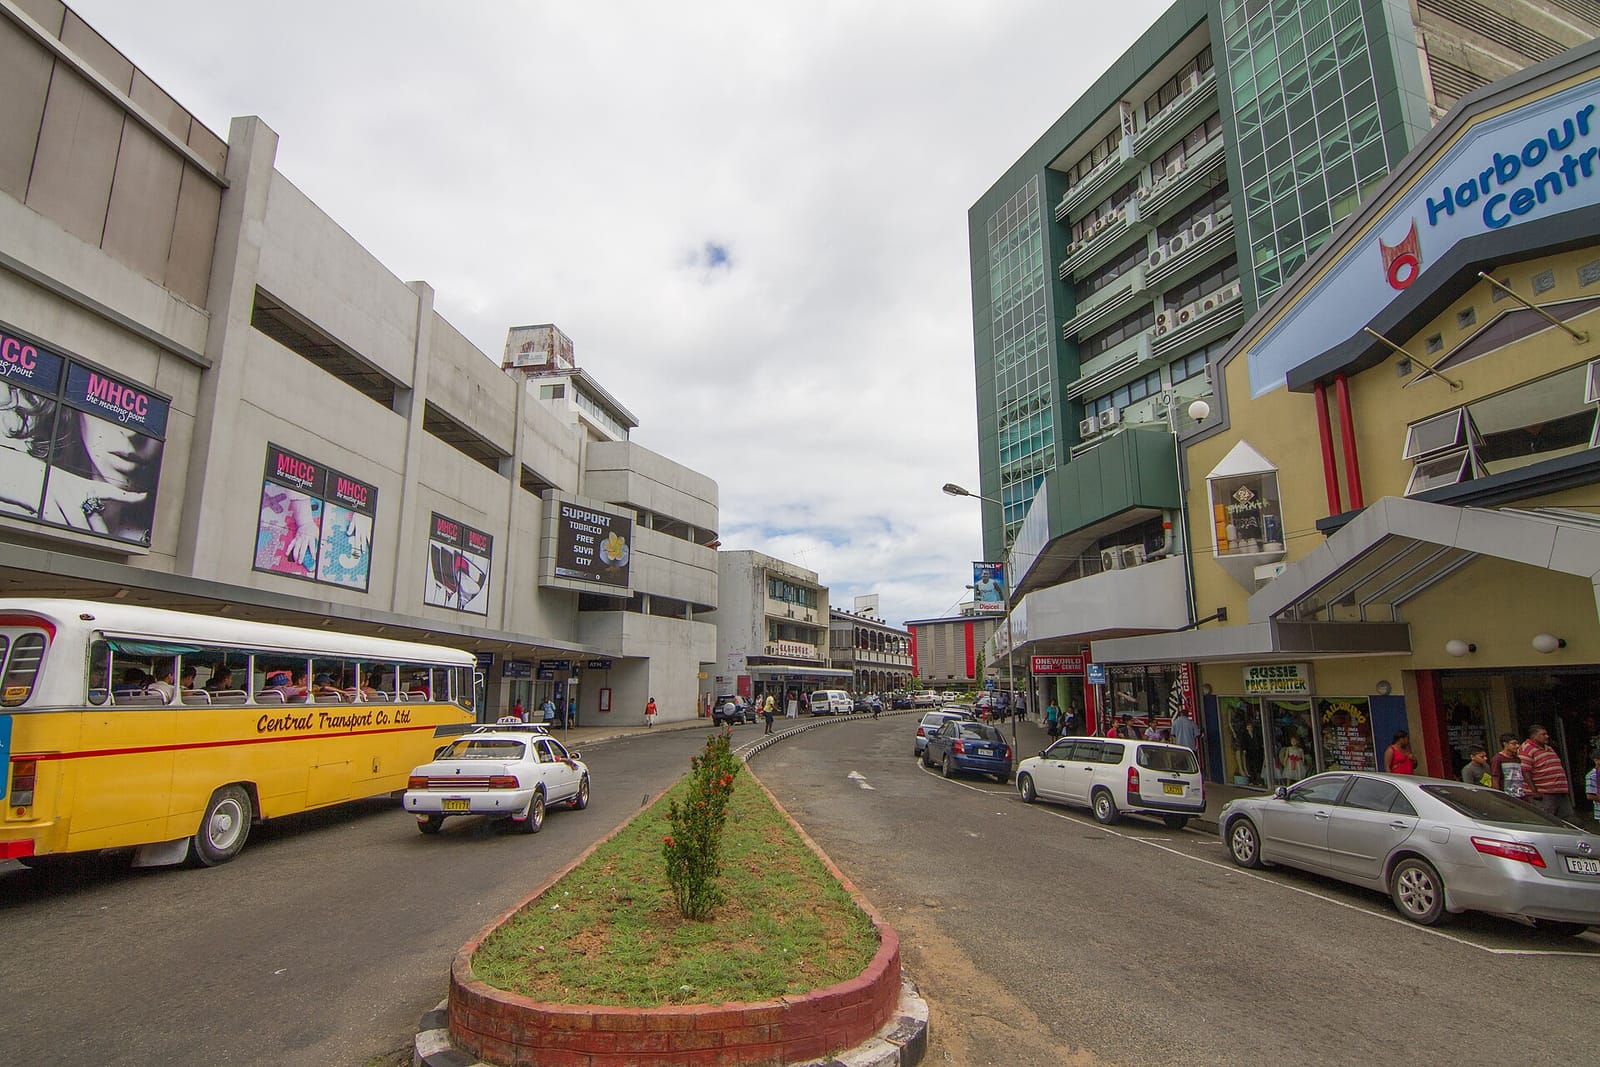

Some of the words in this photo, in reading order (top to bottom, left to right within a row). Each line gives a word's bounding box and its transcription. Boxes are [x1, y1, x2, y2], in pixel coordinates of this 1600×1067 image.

[1426, 104, 1595, 226] Harbour
[1482, 146, 1600, 229] Centr
[0, 335, 37, 370] CC
[6, 363, 35, 378] point
[87, 373, 148, 416] MHCC
[86, 391, 98, 404] the
[98, 400, 128, 422] meeting
[124, 411, 146, 423] point
[278, 453, 314, 482] MHCC
[337, 477, 368, 502] MHCC
[562, 506, 611, 527] SUPPORT
[569, 521, 602, 535] TOBACCO
[576, 534, 594, 544] FREE
[573, 545, 594, 556] SUVA
[576, 557, 592, 566] CITY
[1250, 666, 1298, 678] AUSSIE
[1245, 679, 1269, 690] PRICE
[1270, 679, 1306, 691] FIGHTER
[257, 712, 313, 733] Central
[318, 711, 372, 731] Transport
[375, 710, 391, 725] Co.
[394, 709, 411, 724] Ltd
